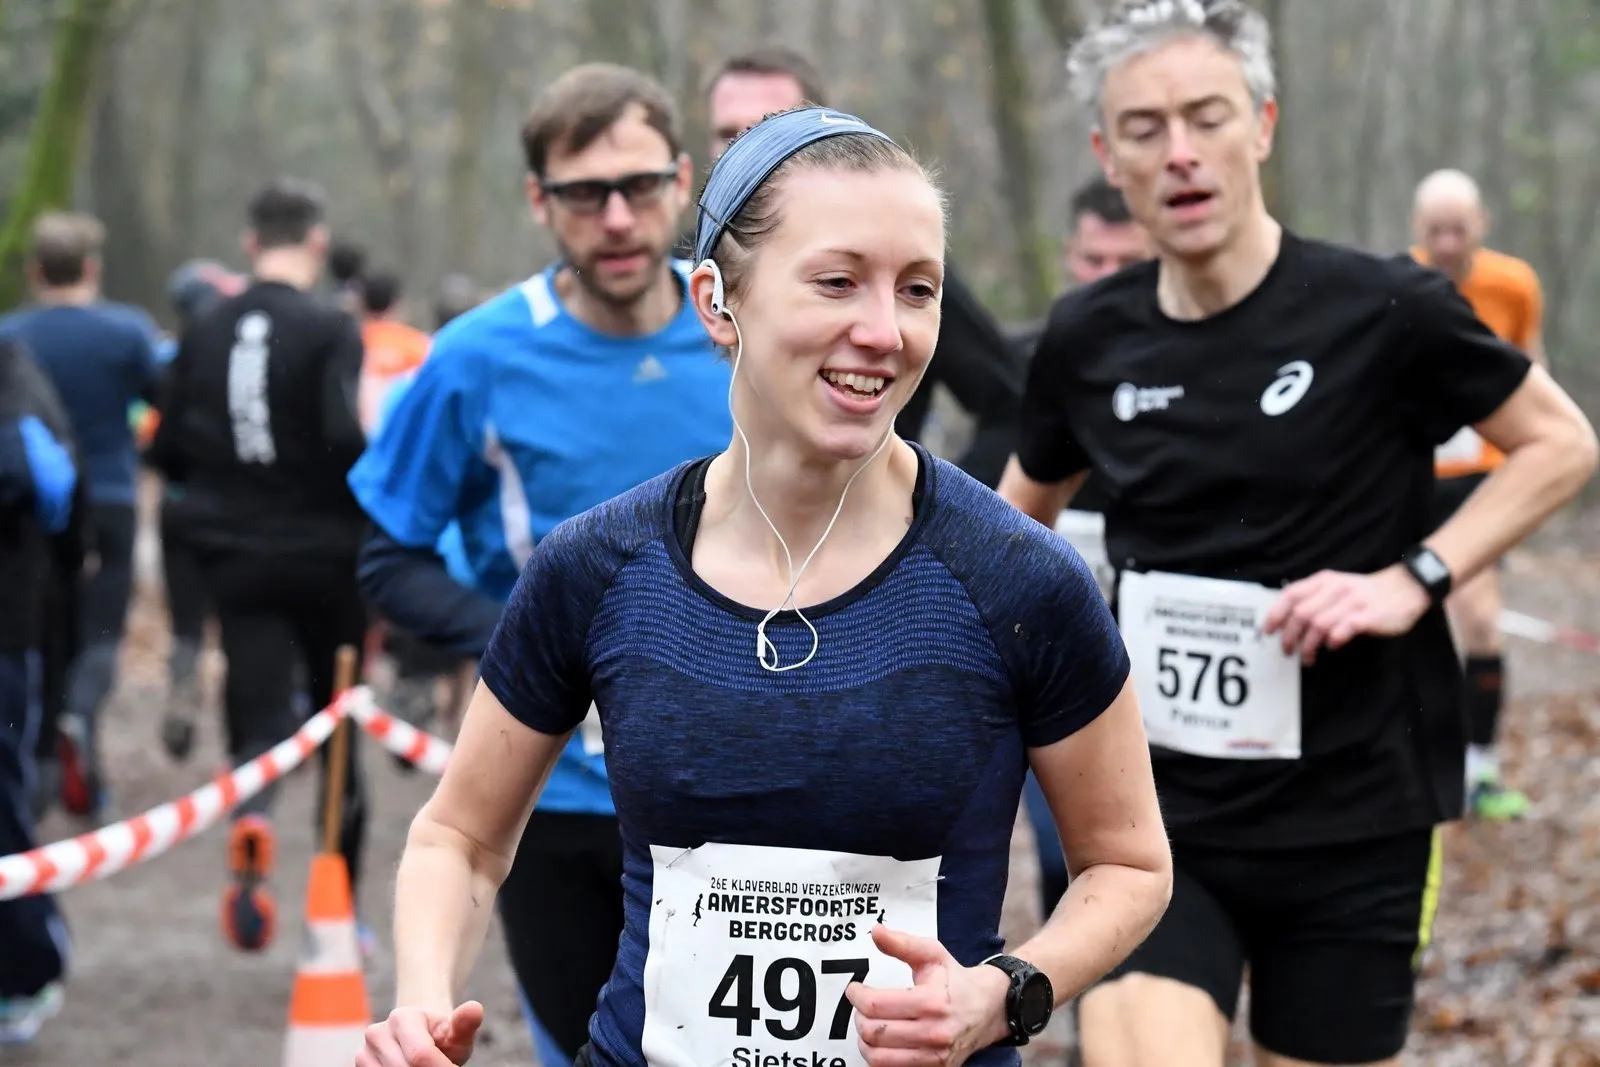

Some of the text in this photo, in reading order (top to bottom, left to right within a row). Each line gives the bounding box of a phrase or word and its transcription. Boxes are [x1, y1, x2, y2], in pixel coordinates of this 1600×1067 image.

[1157, 647, 1249, 708] 576
[711, 877, 881, 897] 26E KLAVERBLAD VERZEKERINGEN
[708, 893, 879, 918] AMERSFOORTSE
[729, 920, 857, 943] BERGCROSS
[708, 954, 870, 1041] 497
[731, 1047, 847, 1067] Sietske
